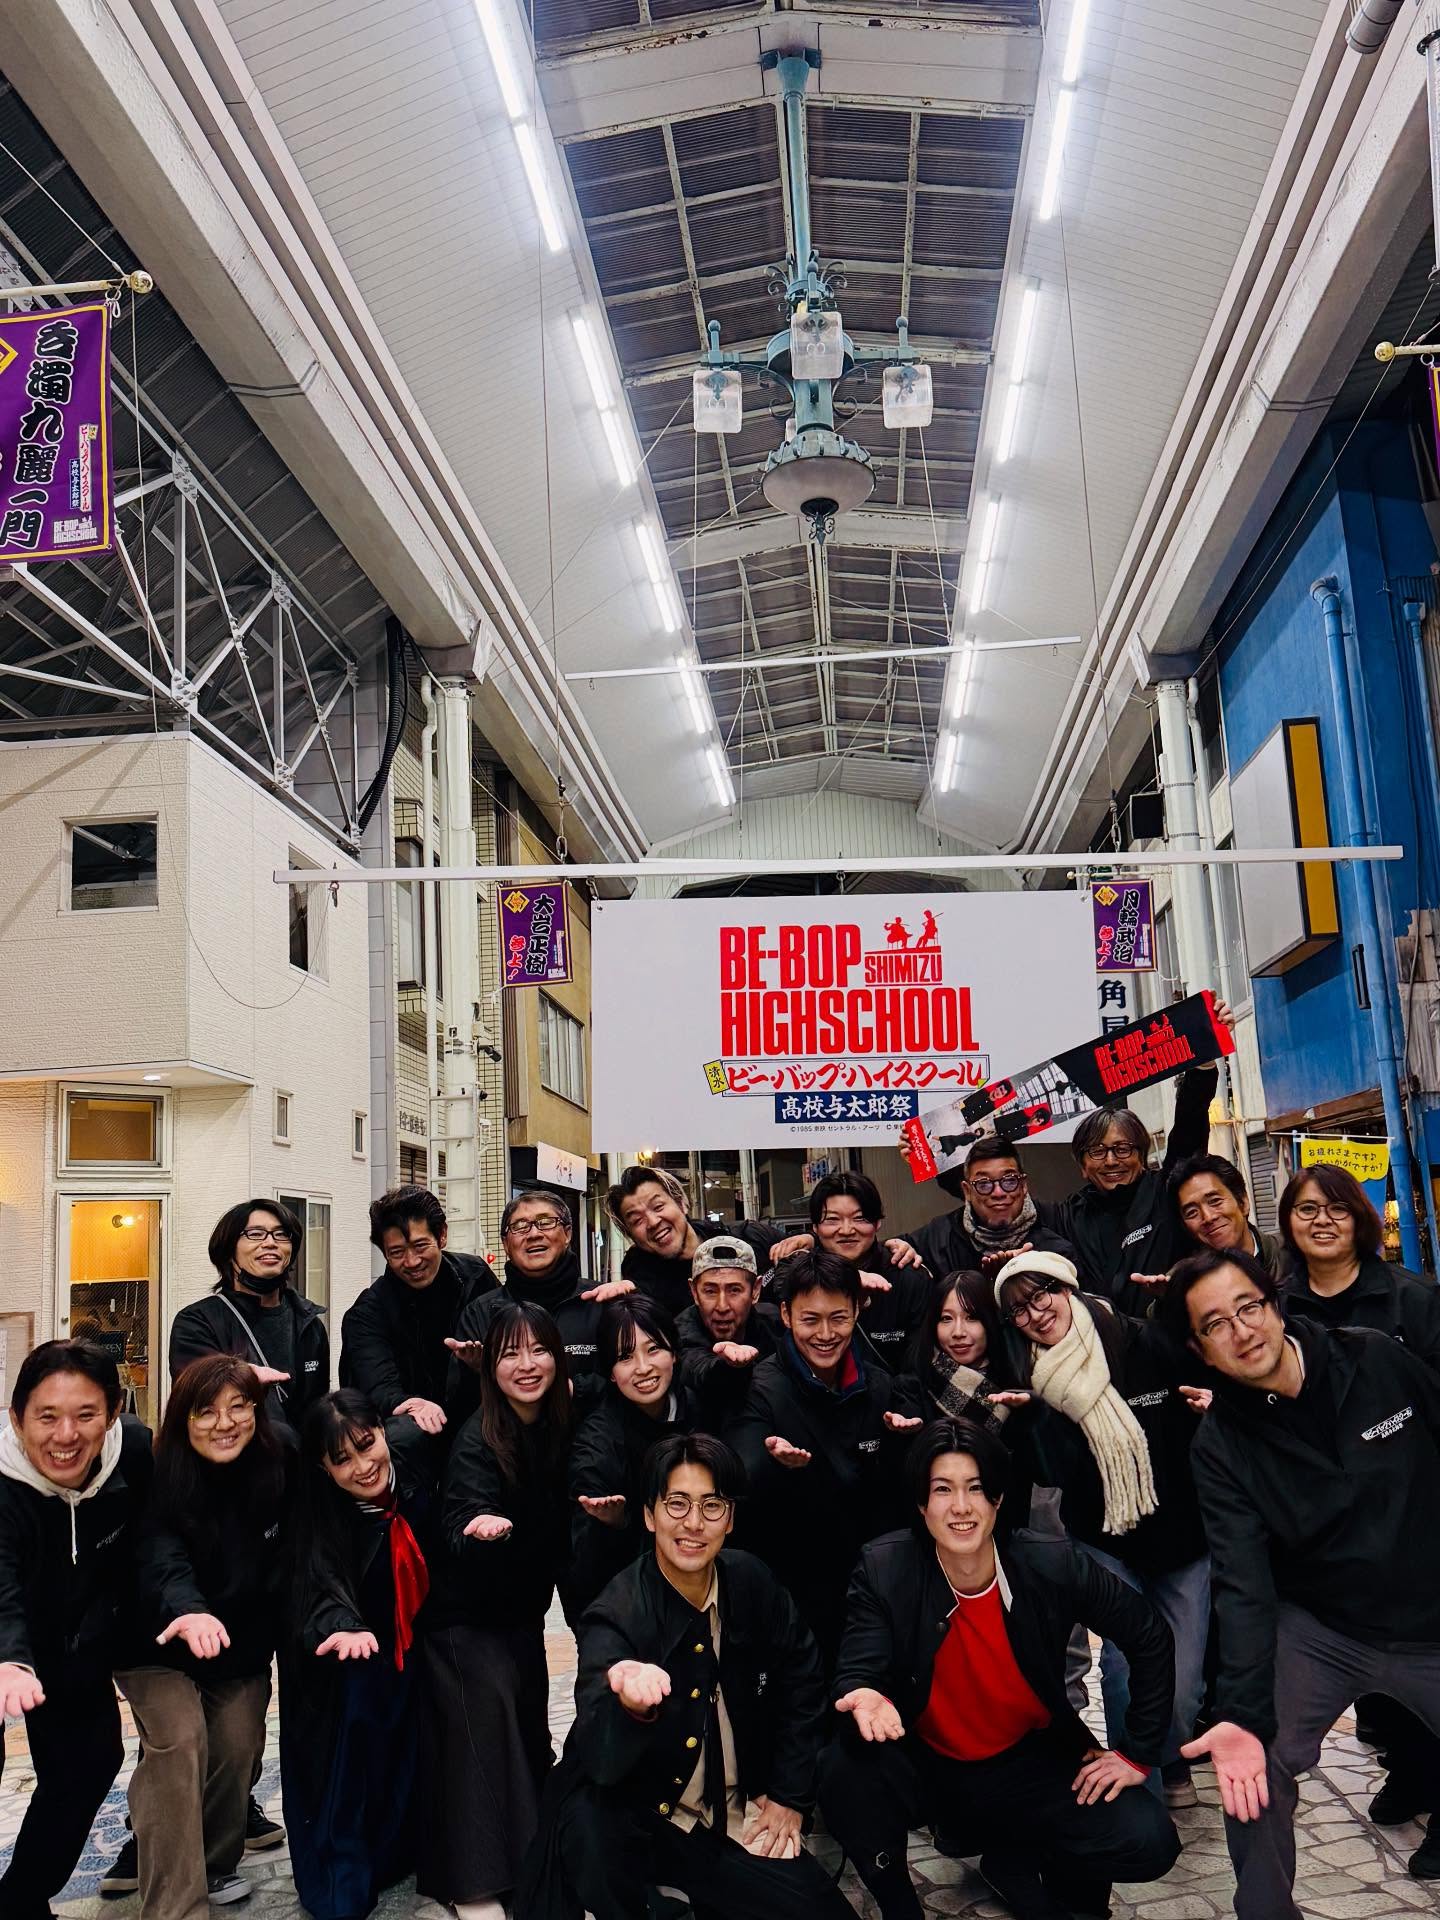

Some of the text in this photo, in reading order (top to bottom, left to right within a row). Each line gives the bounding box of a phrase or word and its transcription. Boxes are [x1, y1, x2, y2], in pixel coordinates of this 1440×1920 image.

[720, 924, 943, 991] BE-BOP SHIMIZU
[720, 986, 980, 1057] HIGHSCHOOL
[1094, 1029, 1146, 1070] BE-BOP
[1101, 1034, 1196, 1095] HIGHSCHOOL
